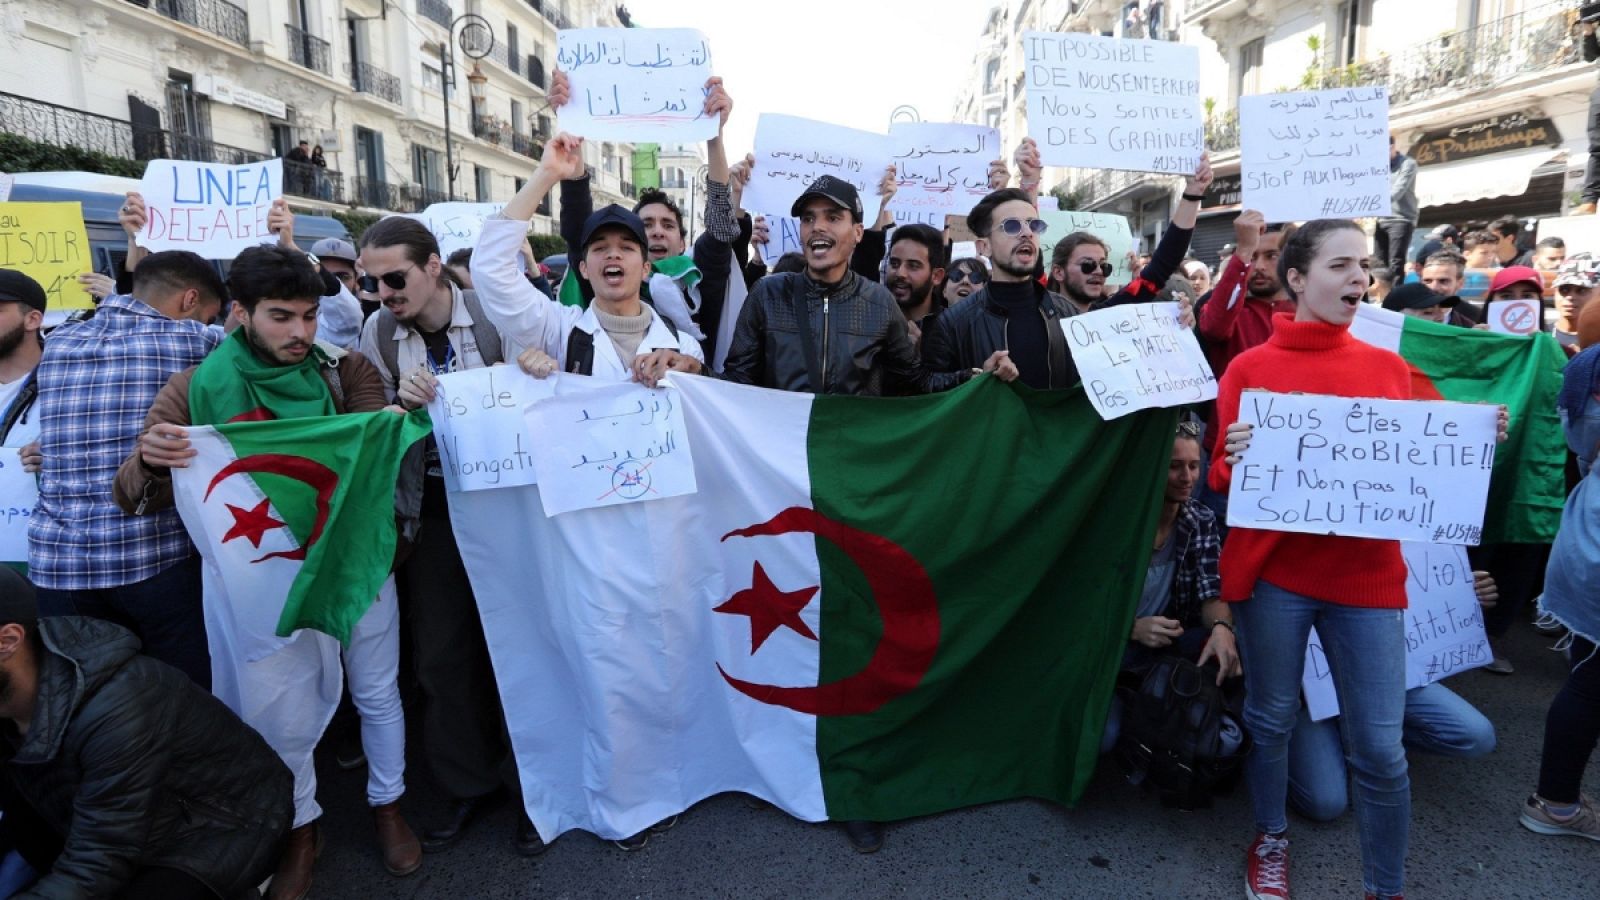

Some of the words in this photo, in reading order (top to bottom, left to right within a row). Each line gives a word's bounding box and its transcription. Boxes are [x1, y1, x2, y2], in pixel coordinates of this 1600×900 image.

[1033, 65, 1071, 87] DE
[1047, 127, 1097, 146] DES
[1433, 127, 1547, 162] Printemps
[172, 166, 271, 206] UNEA
[1304, 170, 1330, 185] AUX
[148, 205, 272, 242] DEGAGE
[1071, 320, 1102, 347] On
[1110, 307, 1147, 334] veut
[1102, 345, 1131, 367] Le
[1132, 334, 1183, 358] MATCH
[482, 372, 517, 409] de
[1090, 380, 1128, 411] Pas
[1346, 403, 1401, 434] êtes
[1424, 412, 1459, 437] Le
[1297, 469, 1344, 490] Non
[1353, 482, 1395, 500] pas
[1410, 477, 1428, 499] la
